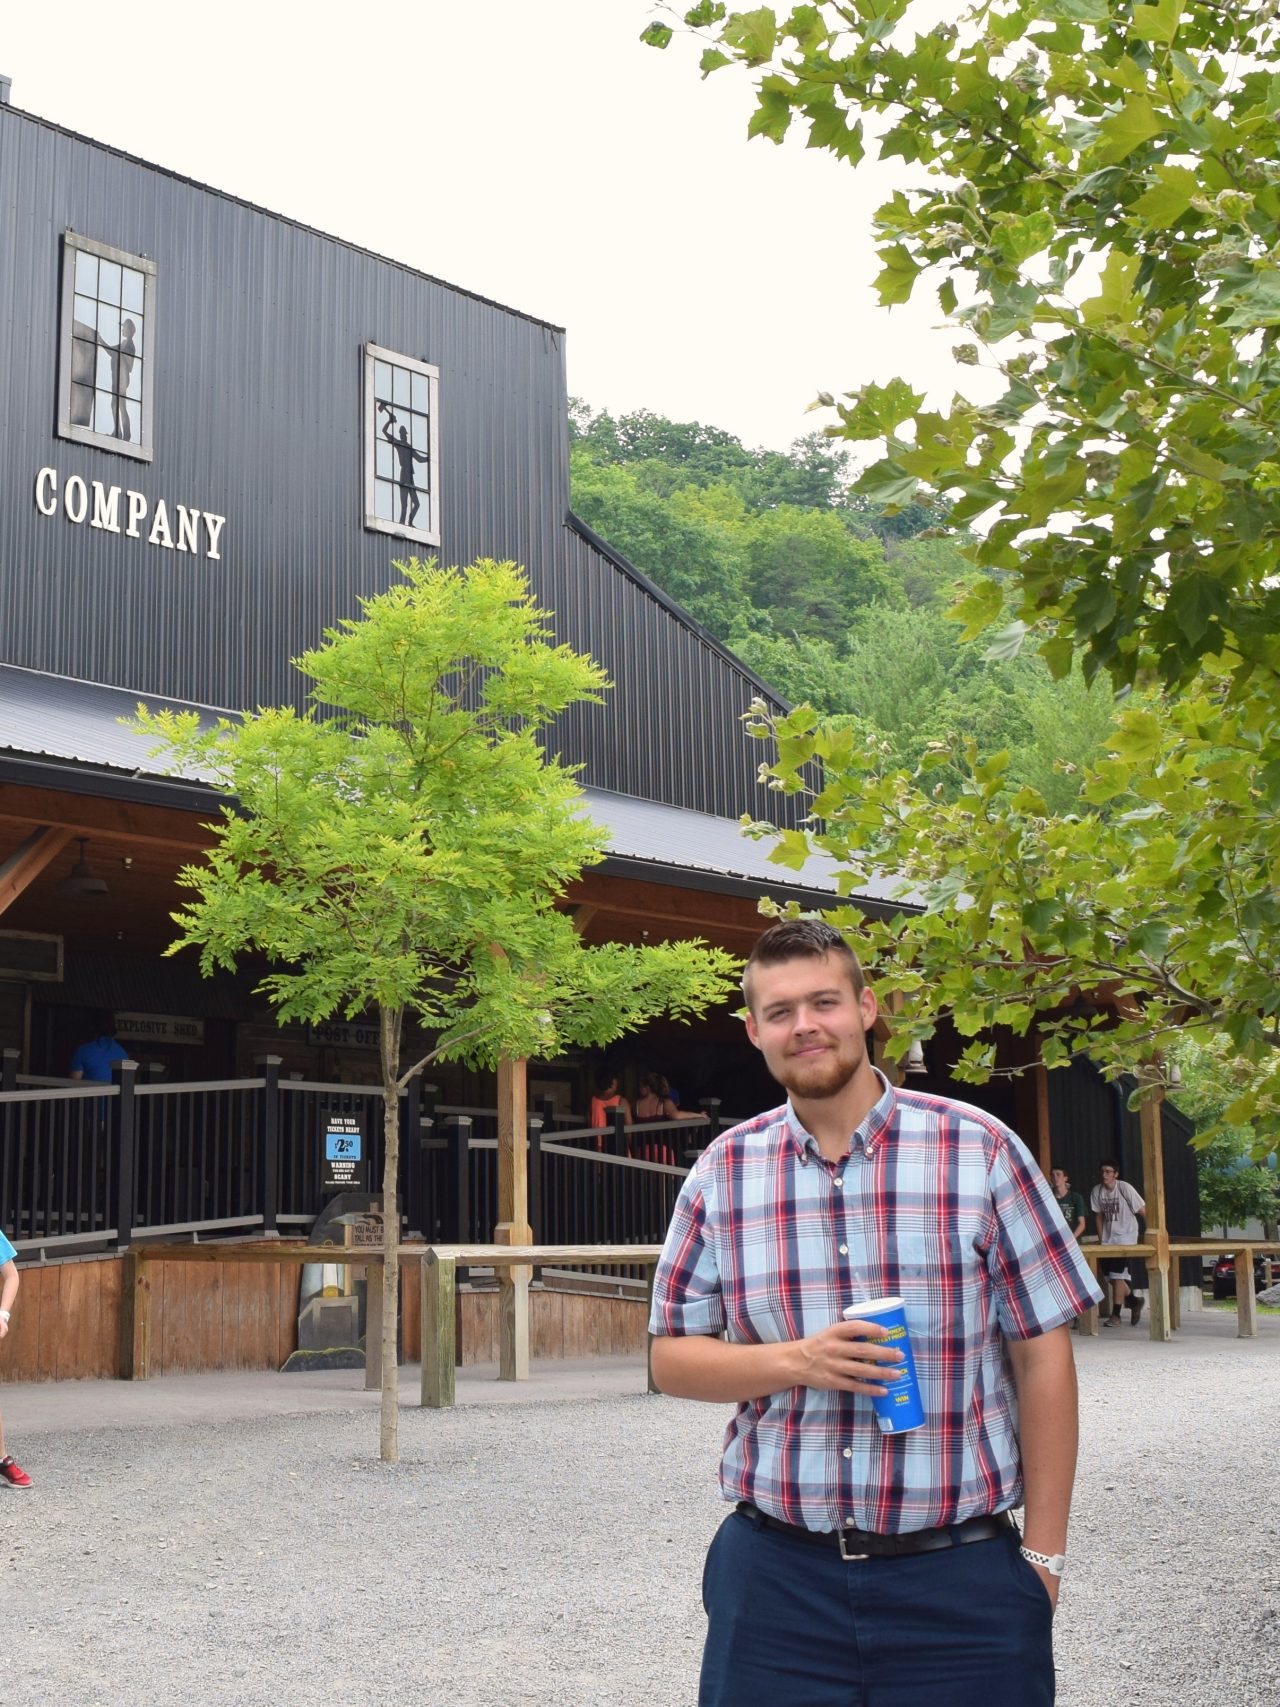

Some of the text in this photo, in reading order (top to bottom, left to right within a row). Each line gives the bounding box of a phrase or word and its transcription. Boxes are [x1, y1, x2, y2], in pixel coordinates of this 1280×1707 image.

[35, 466, 226, 561] COMPANY
[117, 1018, 198, 1036] EXPLOSIVE SHED
[315, 1026, 381, 1045] POST OFF
[354, 1225, 365, 1234] YOU
[365, 1225, 379, 1234] MUST
